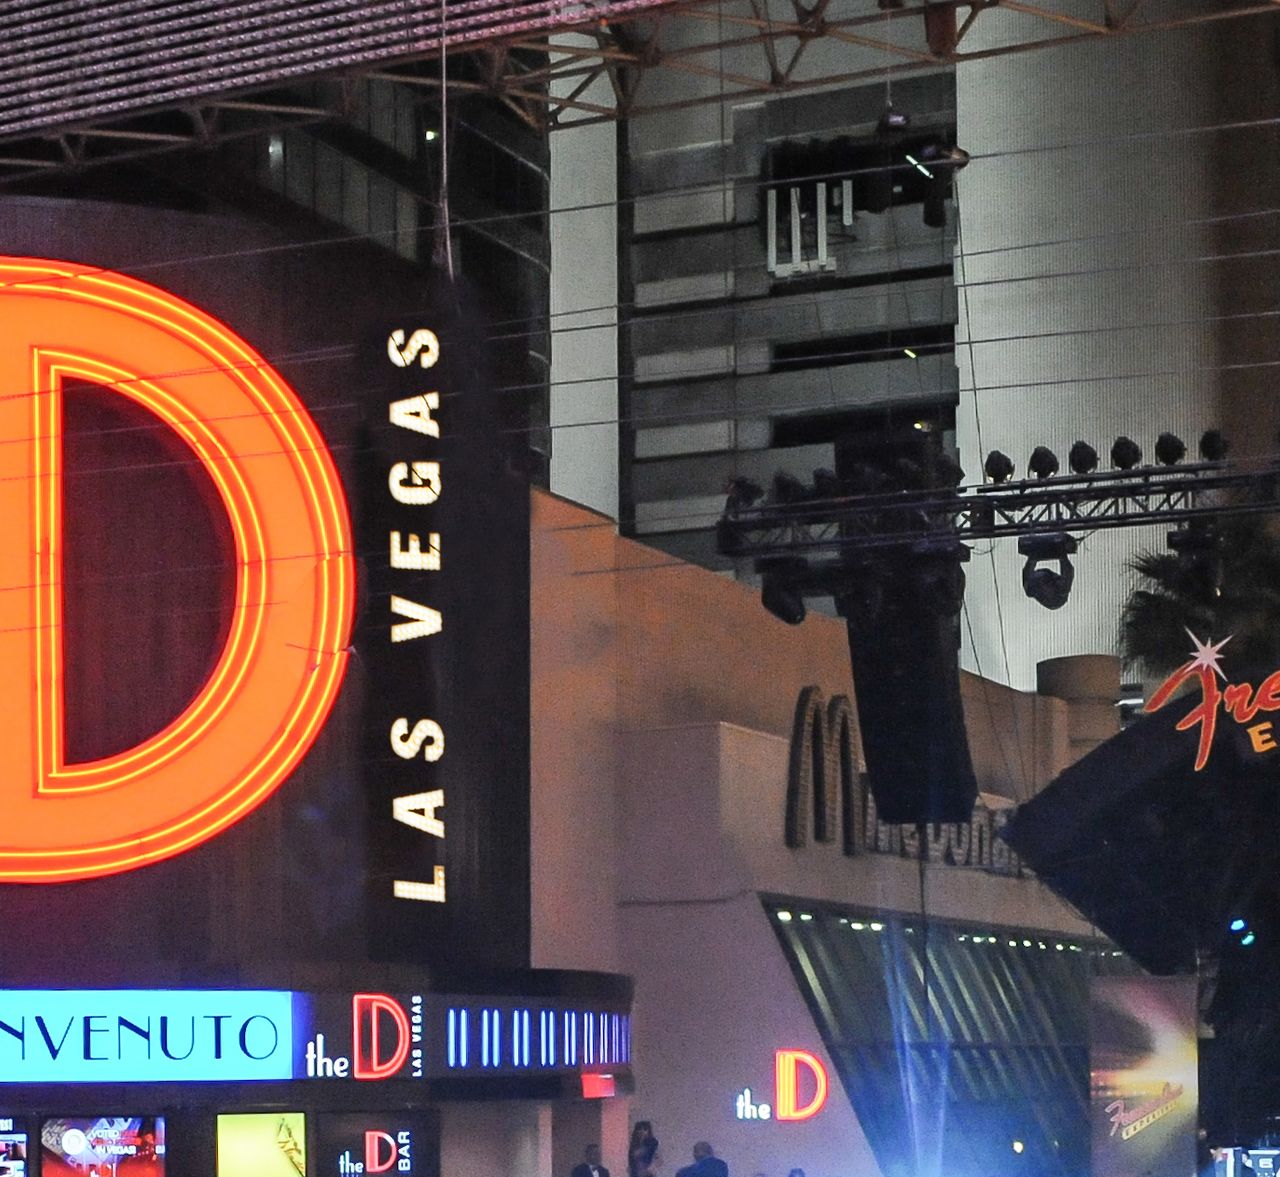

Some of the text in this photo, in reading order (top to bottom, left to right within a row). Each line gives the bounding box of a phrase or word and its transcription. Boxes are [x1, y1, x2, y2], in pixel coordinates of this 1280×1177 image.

[385, 326, 447, 905] LAS VEGAS
[305, 993, 411, 1080] the D
[411, 994, 423, 1037] VEGAS
[735, 1047, 829, 1122] the D
[338, 1129, 398, 1175] the D
[397, 1131, 411, 1172] BAR
